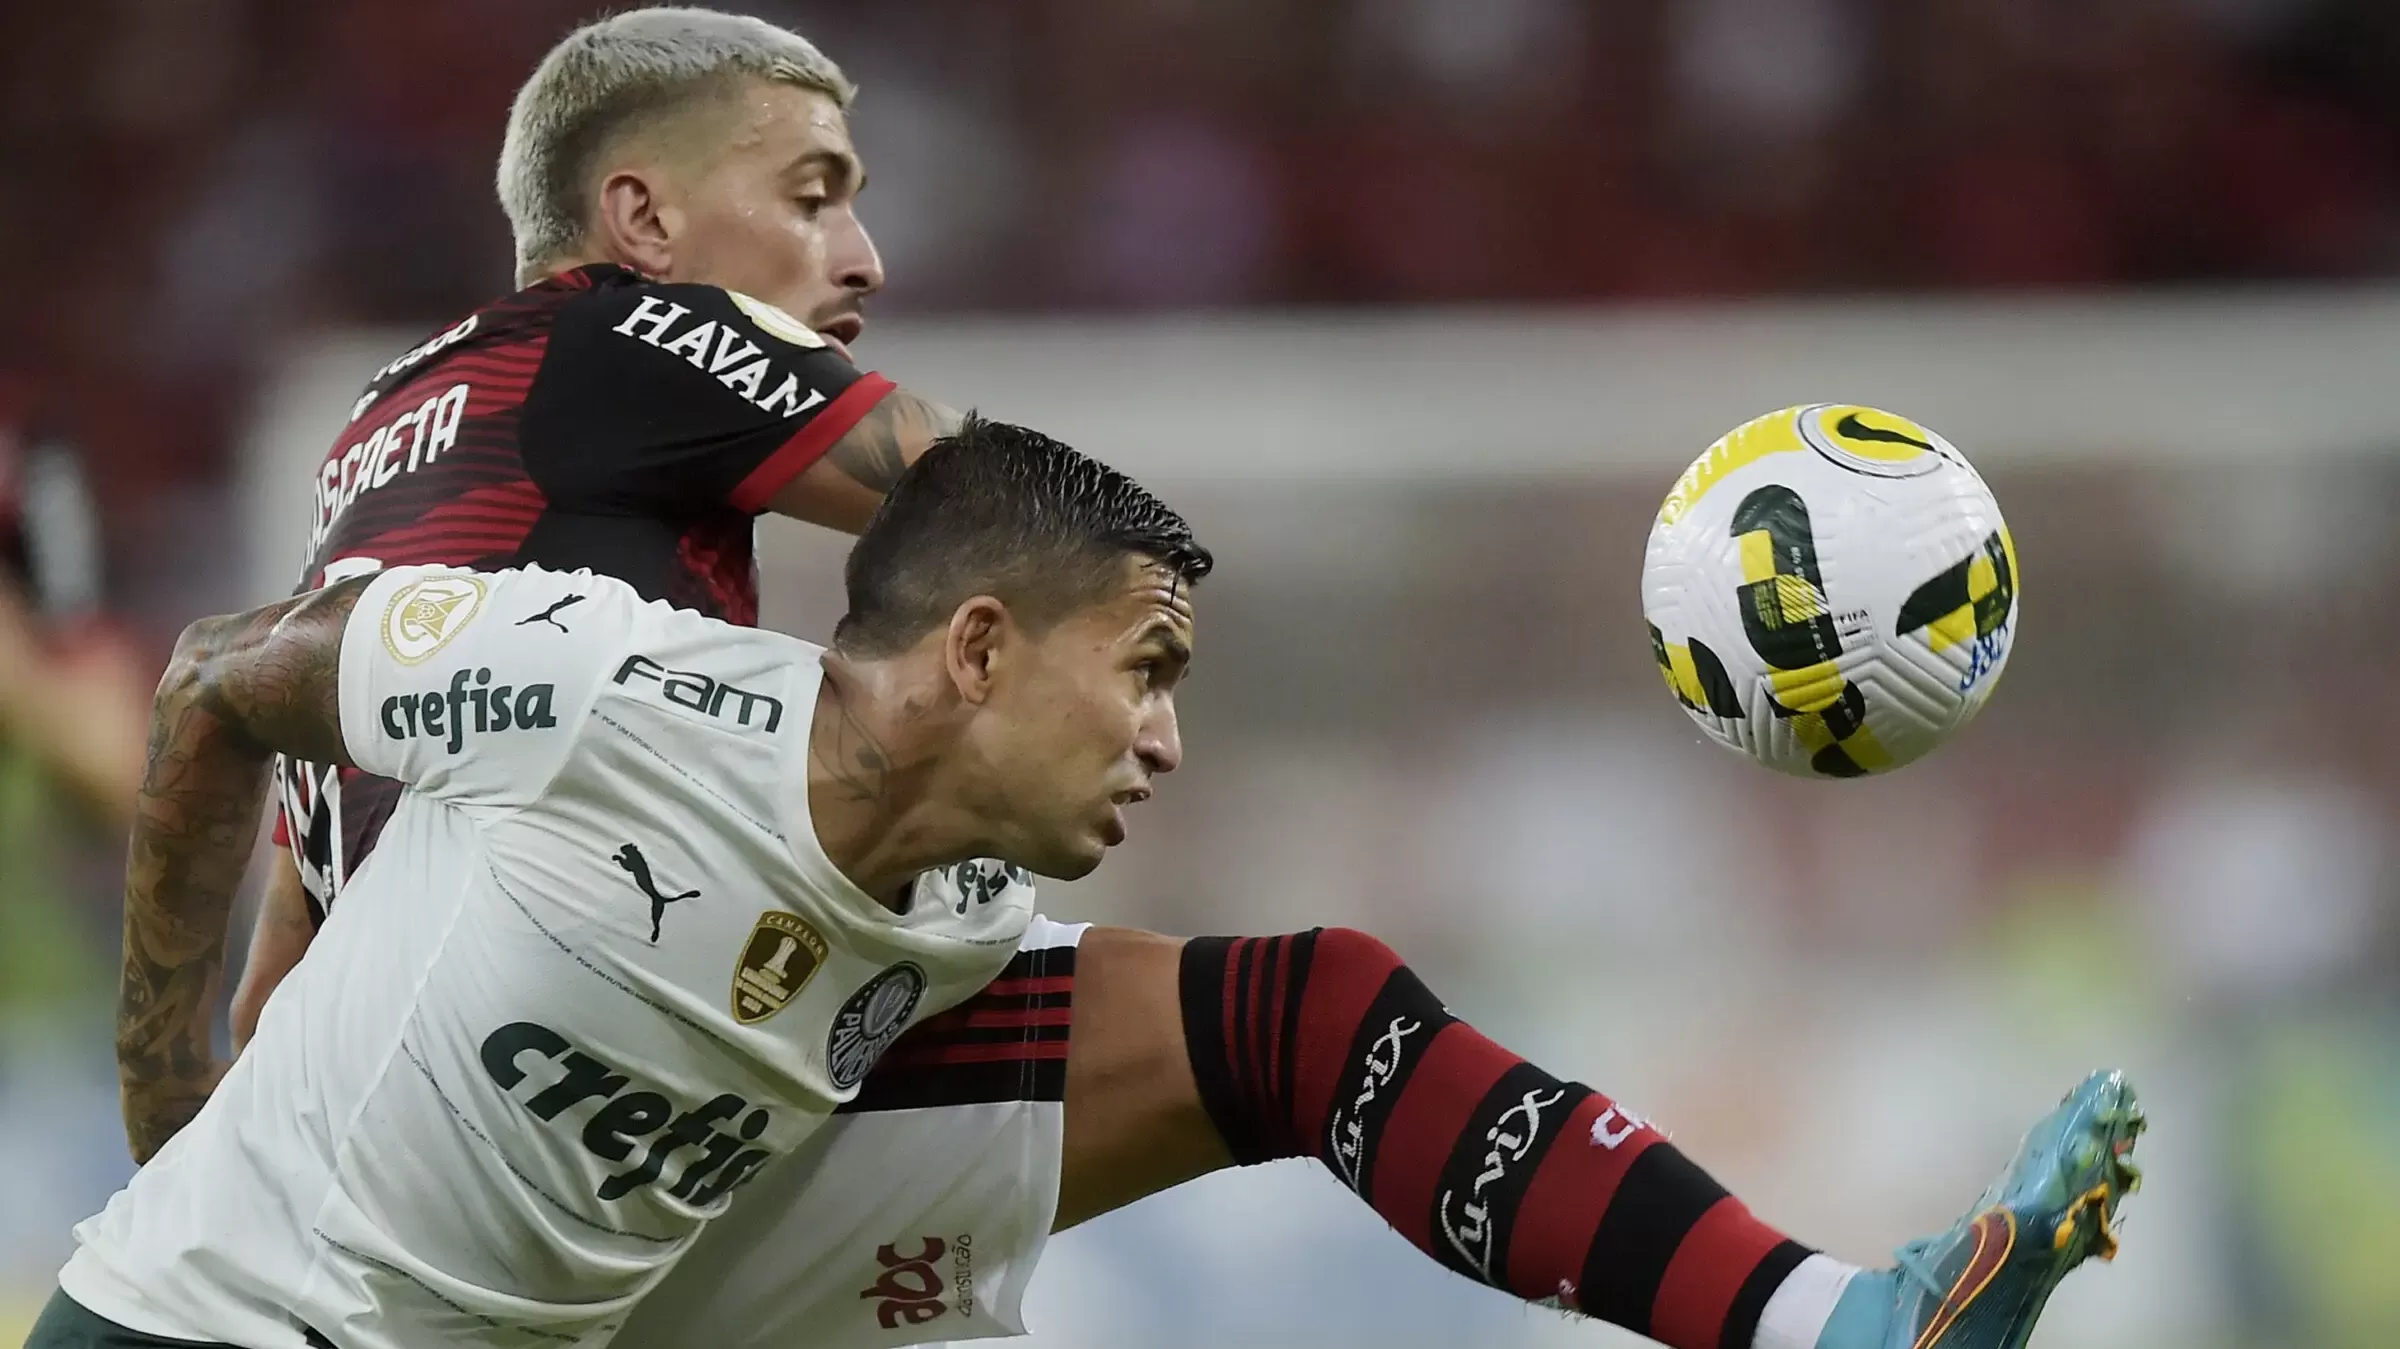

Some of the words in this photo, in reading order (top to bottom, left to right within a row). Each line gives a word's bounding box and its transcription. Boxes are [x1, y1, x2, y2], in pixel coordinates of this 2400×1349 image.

[613, 294, 828, 419] HAVAN
[1838, 608, 1870, 625] FIFA
[381, 667, 557, 755] crefisa
[480, 1021, 771, 1207] crefis
[860, 1236, 948, 1329] abc
